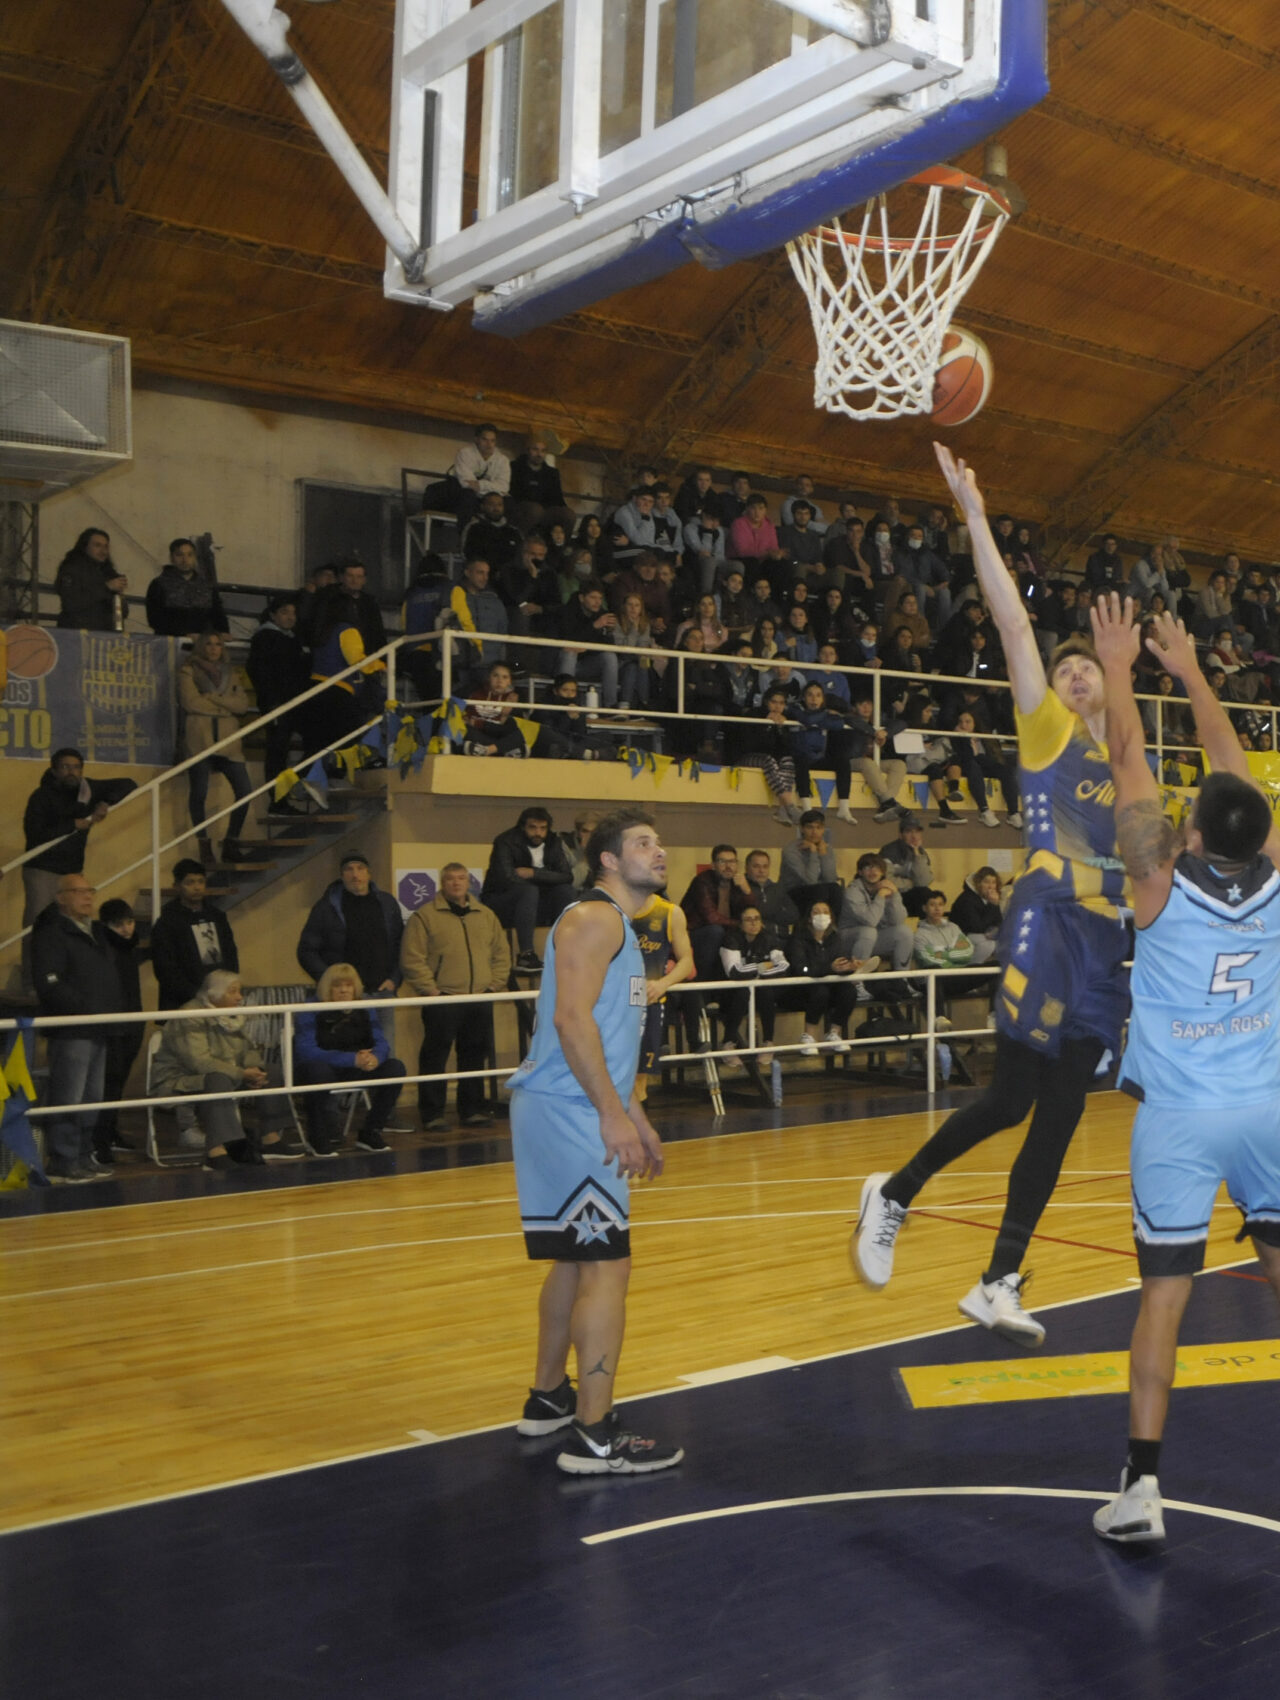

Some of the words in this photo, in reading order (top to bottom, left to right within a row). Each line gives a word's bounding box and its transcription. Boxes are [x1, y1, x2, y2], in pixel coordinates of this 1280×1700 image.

[1207, 949, 1263, 1006] 5
[1171, 1019, 1226, 1041] SANTA
[1229, 1011, 1272, 1034] ROSA
[645, 1052, 655, 1069] 7
[1203, 1355, 1256, 1368] de
[949, 1366, 1120, 1387] Pampa
